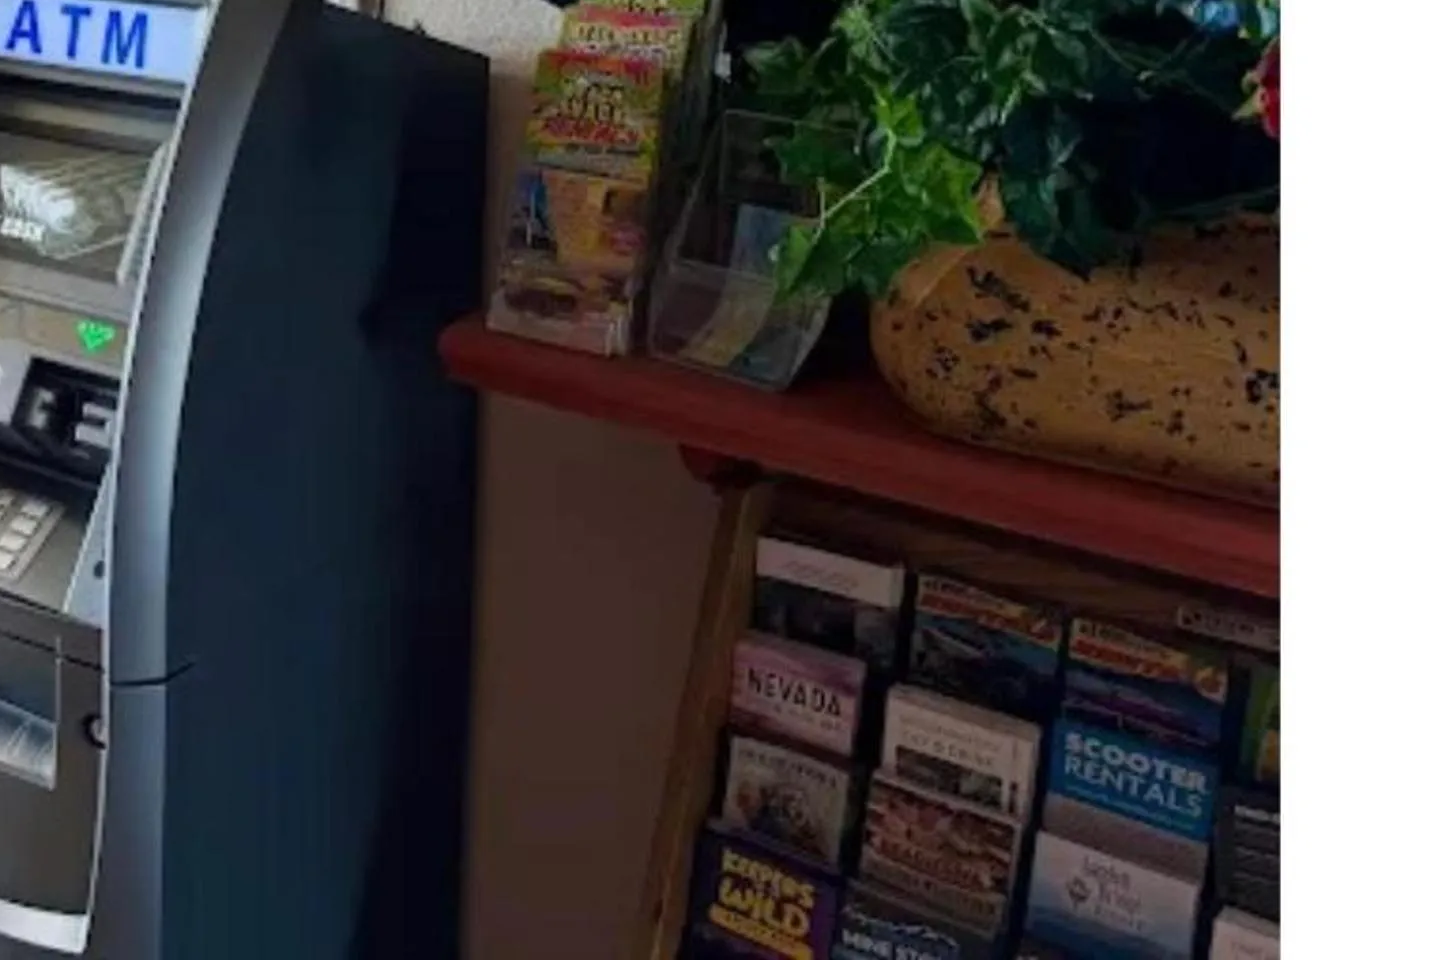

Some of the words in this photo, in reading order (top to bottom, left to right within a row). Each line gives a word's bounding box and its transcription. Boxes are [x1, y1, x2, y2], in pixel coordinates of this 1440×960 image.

[746, 667, 843, 719] NEVADA
[1063, 730, 1208, 795] SCOOTER
[1063, 758, 1203, 818] RENTALS
